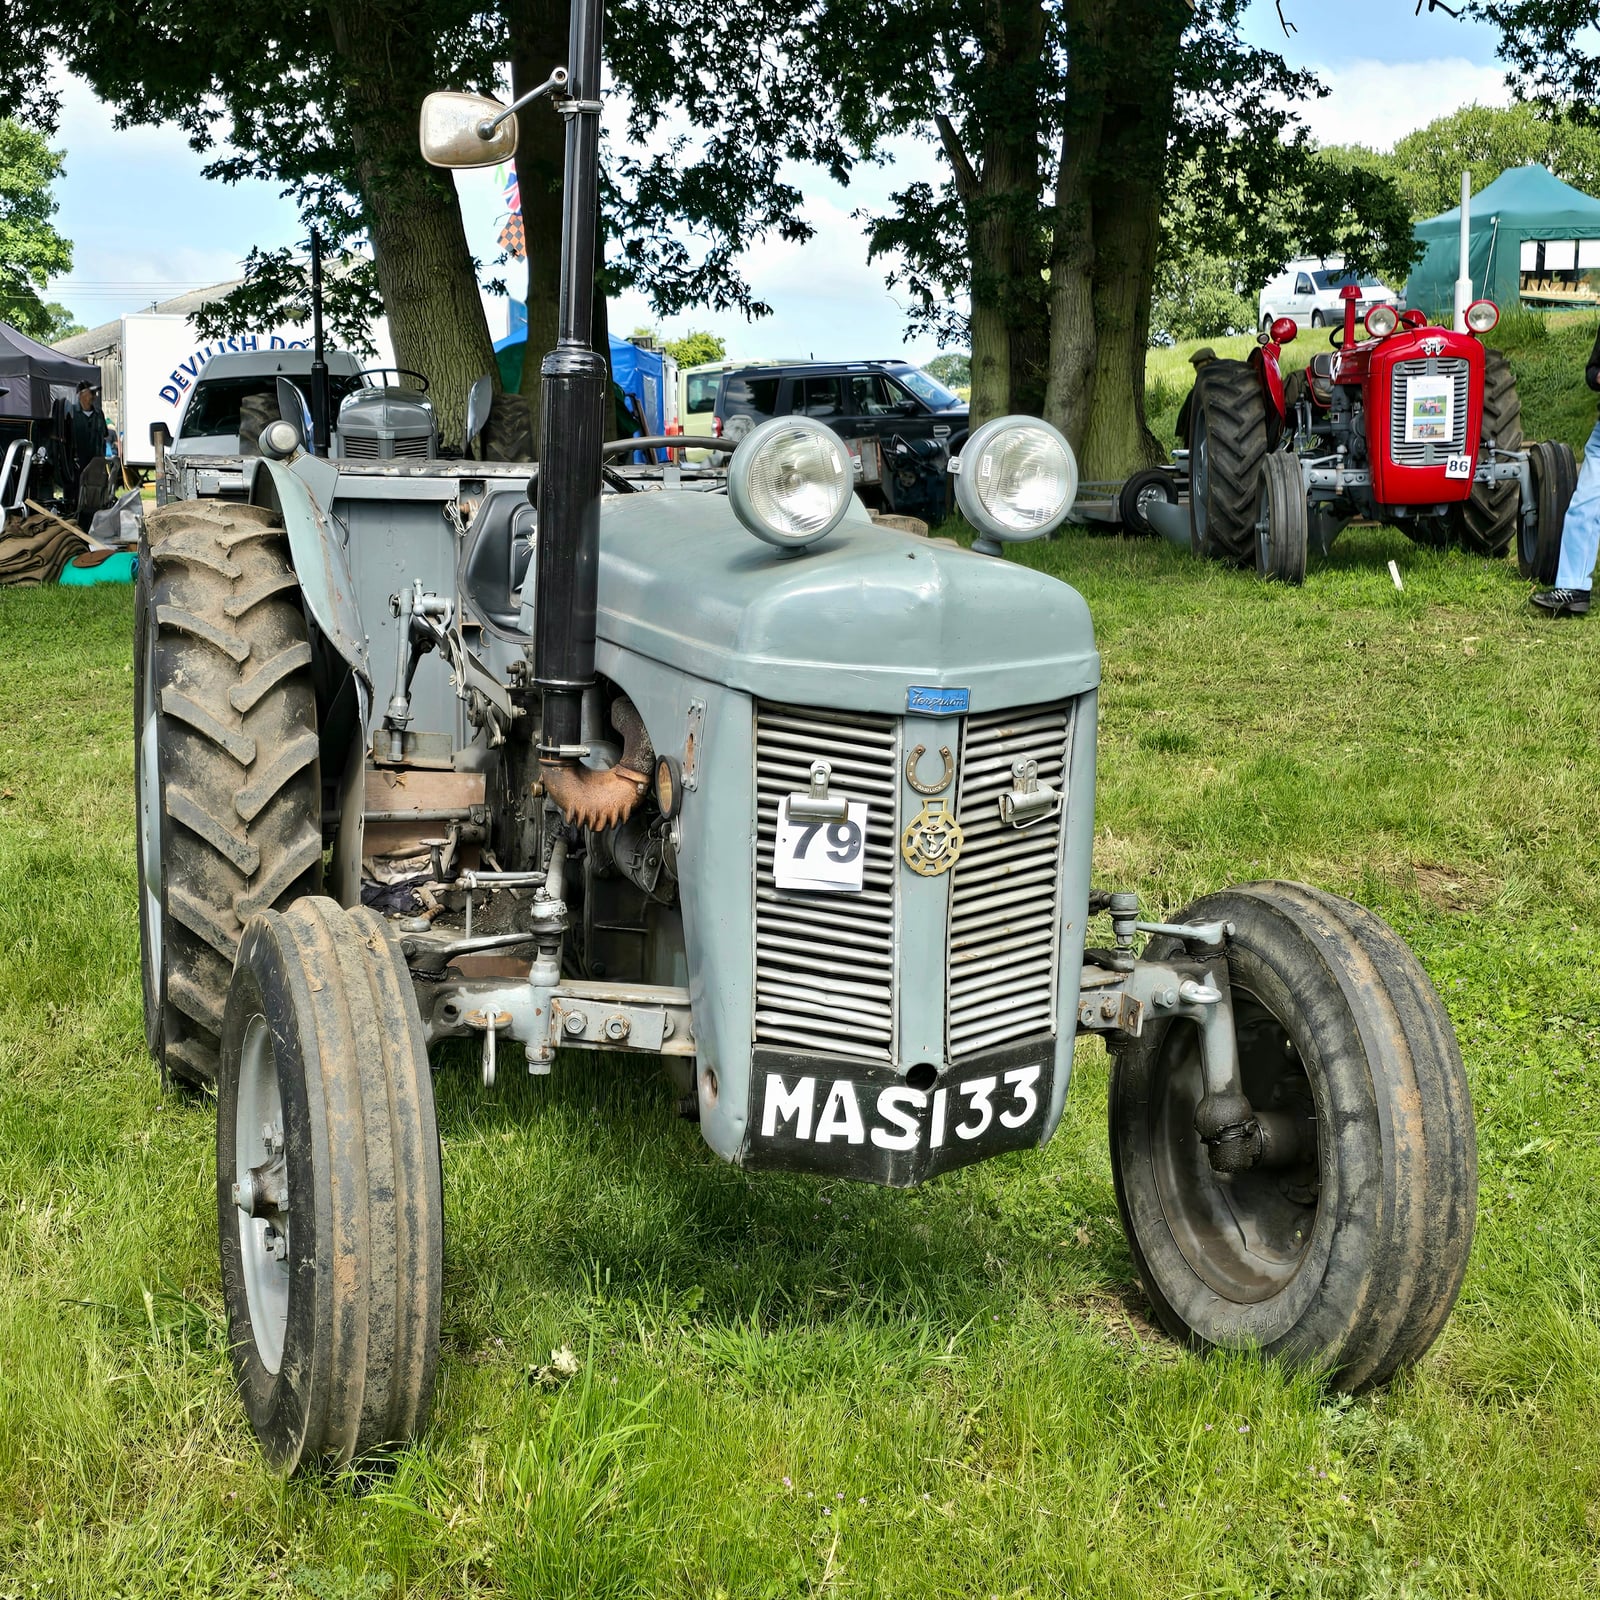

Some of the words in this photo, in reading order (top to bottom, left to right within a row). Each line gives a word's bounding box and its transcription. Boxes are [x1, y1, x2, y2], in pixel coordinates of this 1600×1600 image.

[159, 335, 259, 407] DEVILISH
[1448, 460, 1469, 473] 86
[911, 688, 966, 709] Ferguson
[788, 820, 862, 864] 79
